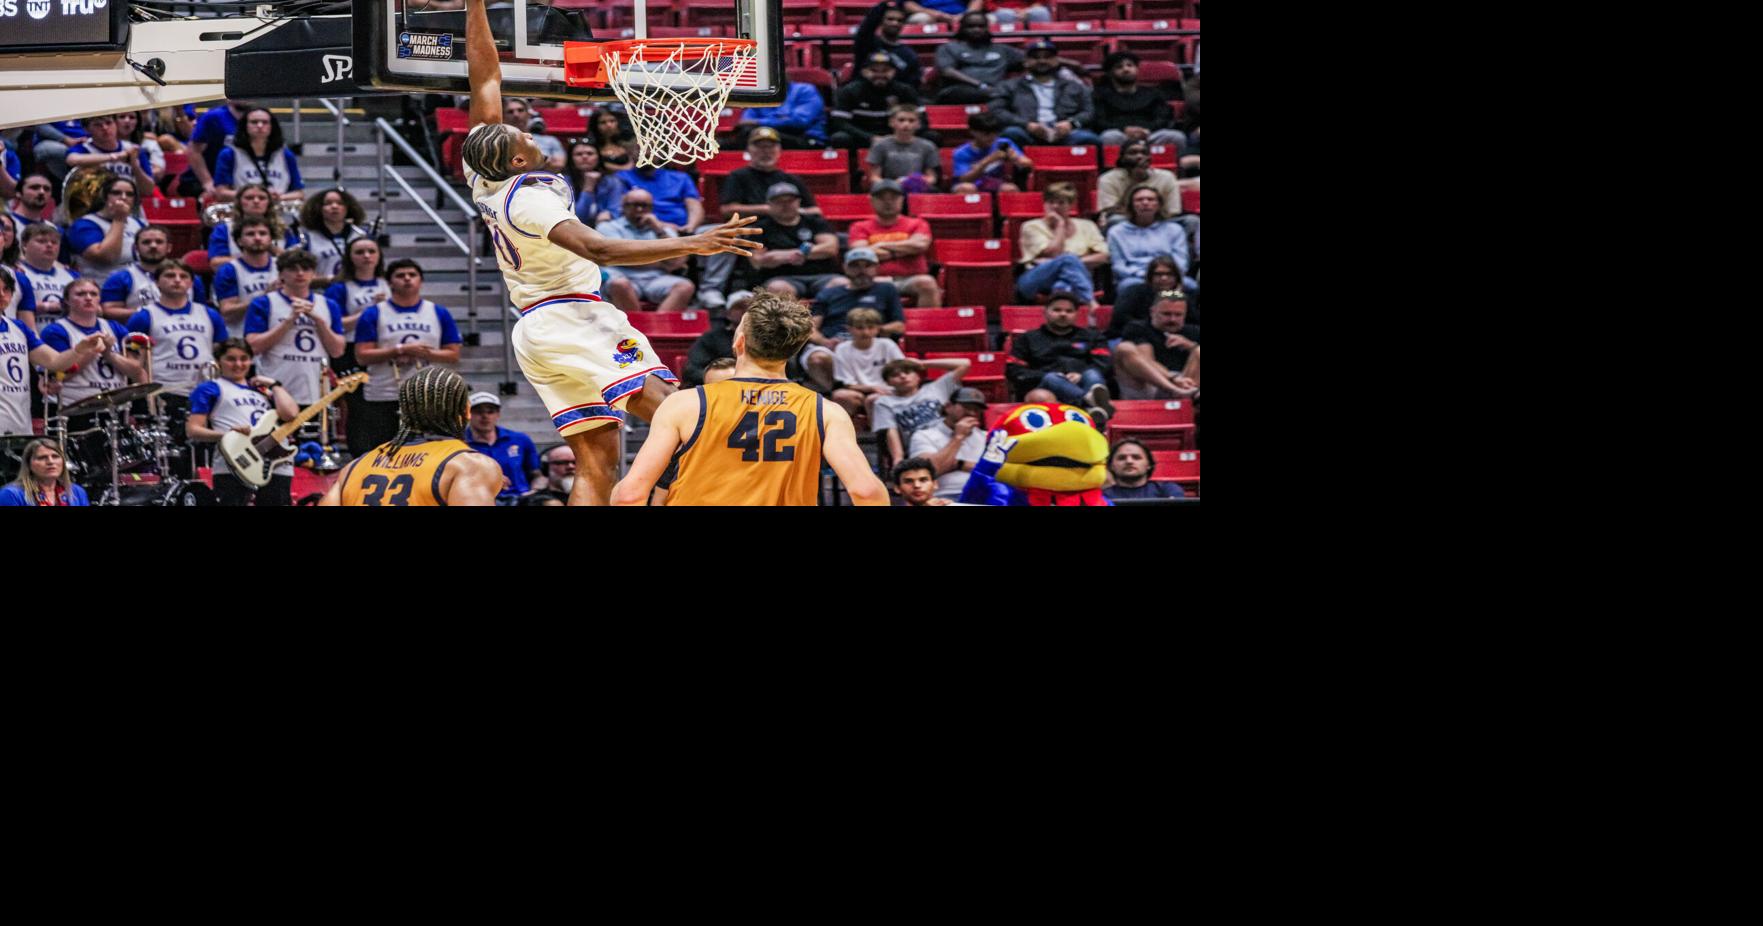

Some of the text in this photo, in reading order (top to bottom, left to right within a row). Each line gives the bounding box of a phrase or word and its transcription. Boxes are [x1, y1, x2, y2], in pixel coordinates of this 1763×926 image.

[410, 34, 438, 45] MARCH
[412, 45, 451, 56] MADNESS
[321, 54, 353, 84] SP
[162, 323, 205, 334] KANSAS
[387, 322, 431, 333] KANSAS
[0, 343, 26, 355] ANSAS
[176, 336, 199, 360] 6
[295, 328, 316, 353] 6
[7, 356, 23, 383] 6
[727, 410, 797, 462] 42
[361, 474, 415, 506] 33
